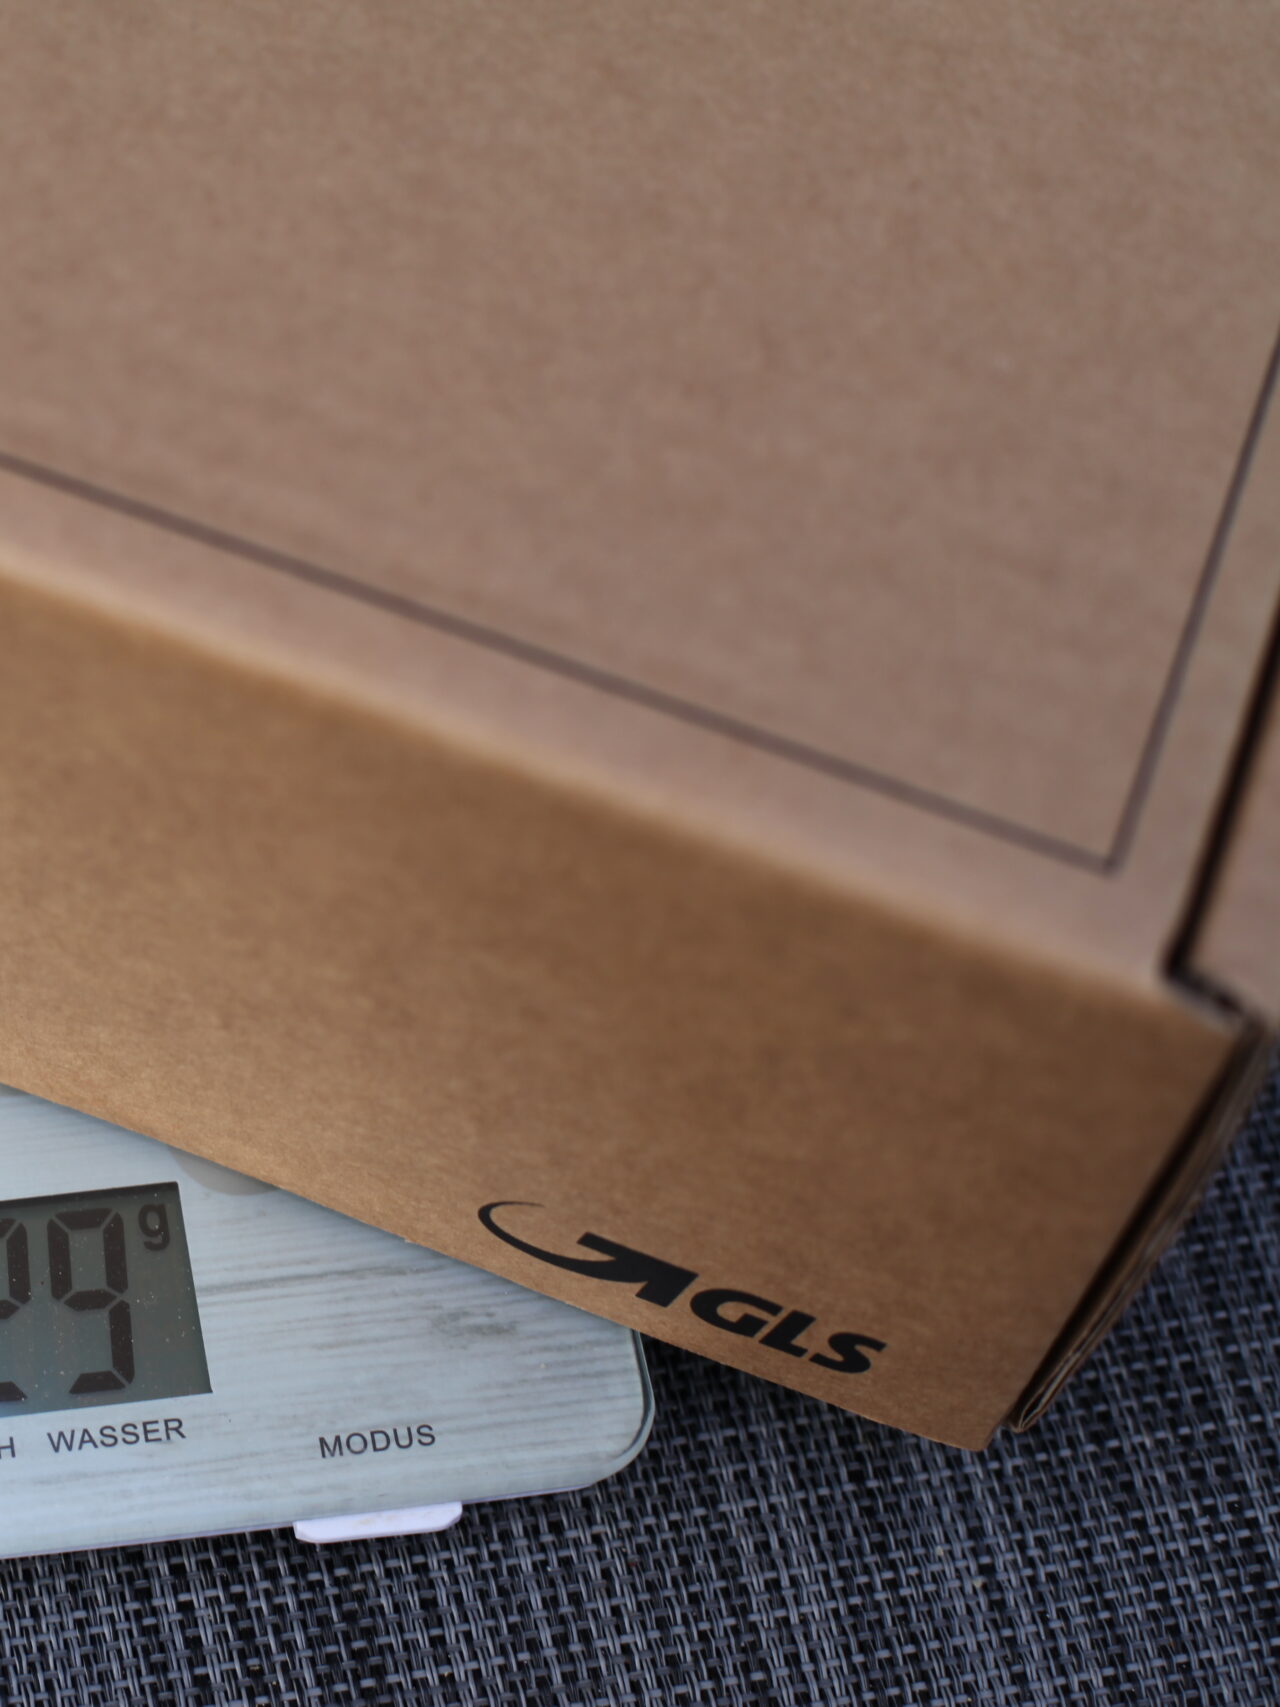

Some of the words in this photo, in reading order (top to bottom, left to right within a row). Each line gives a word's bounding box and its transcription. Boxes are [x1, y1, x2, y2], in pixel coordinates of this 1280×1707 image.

[137, 1202, 171, 1251] g
[690, 1288, 888, 1374] GLS
[46, 1417, 187, 1454] WASSER
[318, 1424, 436, 1458] MODUS
